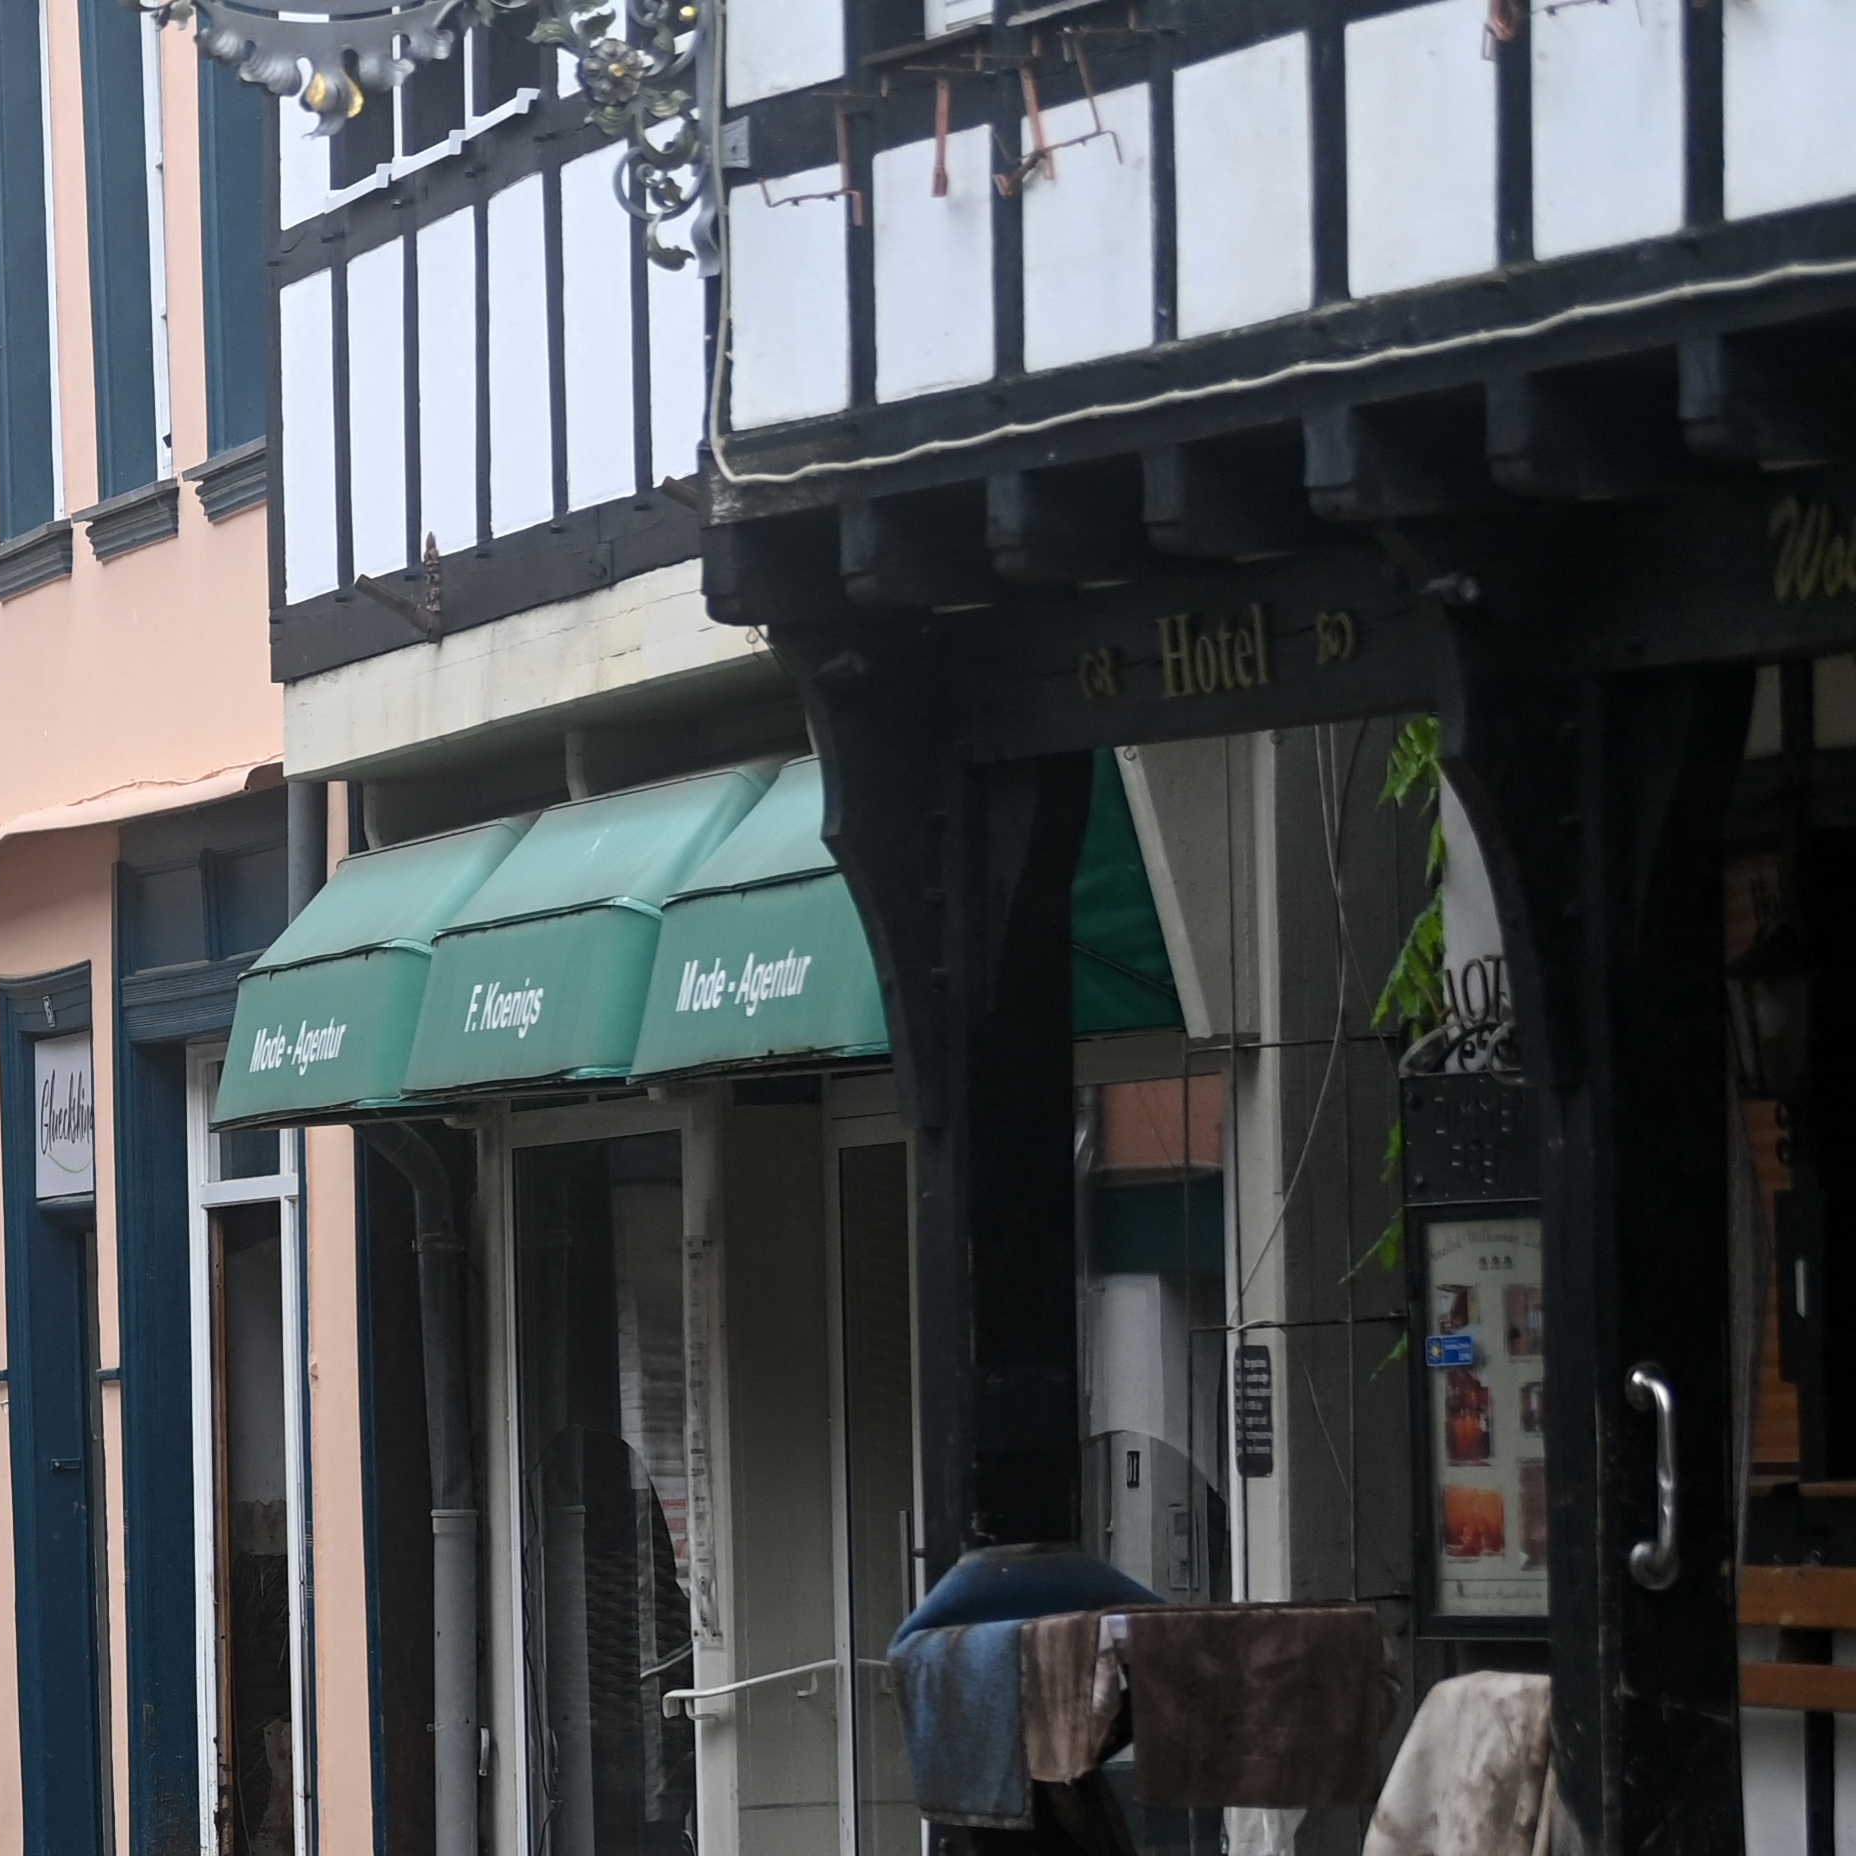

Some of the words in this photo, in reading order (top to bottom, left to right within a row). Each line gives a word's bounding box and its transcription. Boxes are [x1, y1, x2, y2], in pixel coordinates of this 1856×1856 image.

[1155, 602, 1268, 698] Hotel
[464, 984, 483, 1033] F.
[479, 977, 544, 1039] Koenigs
